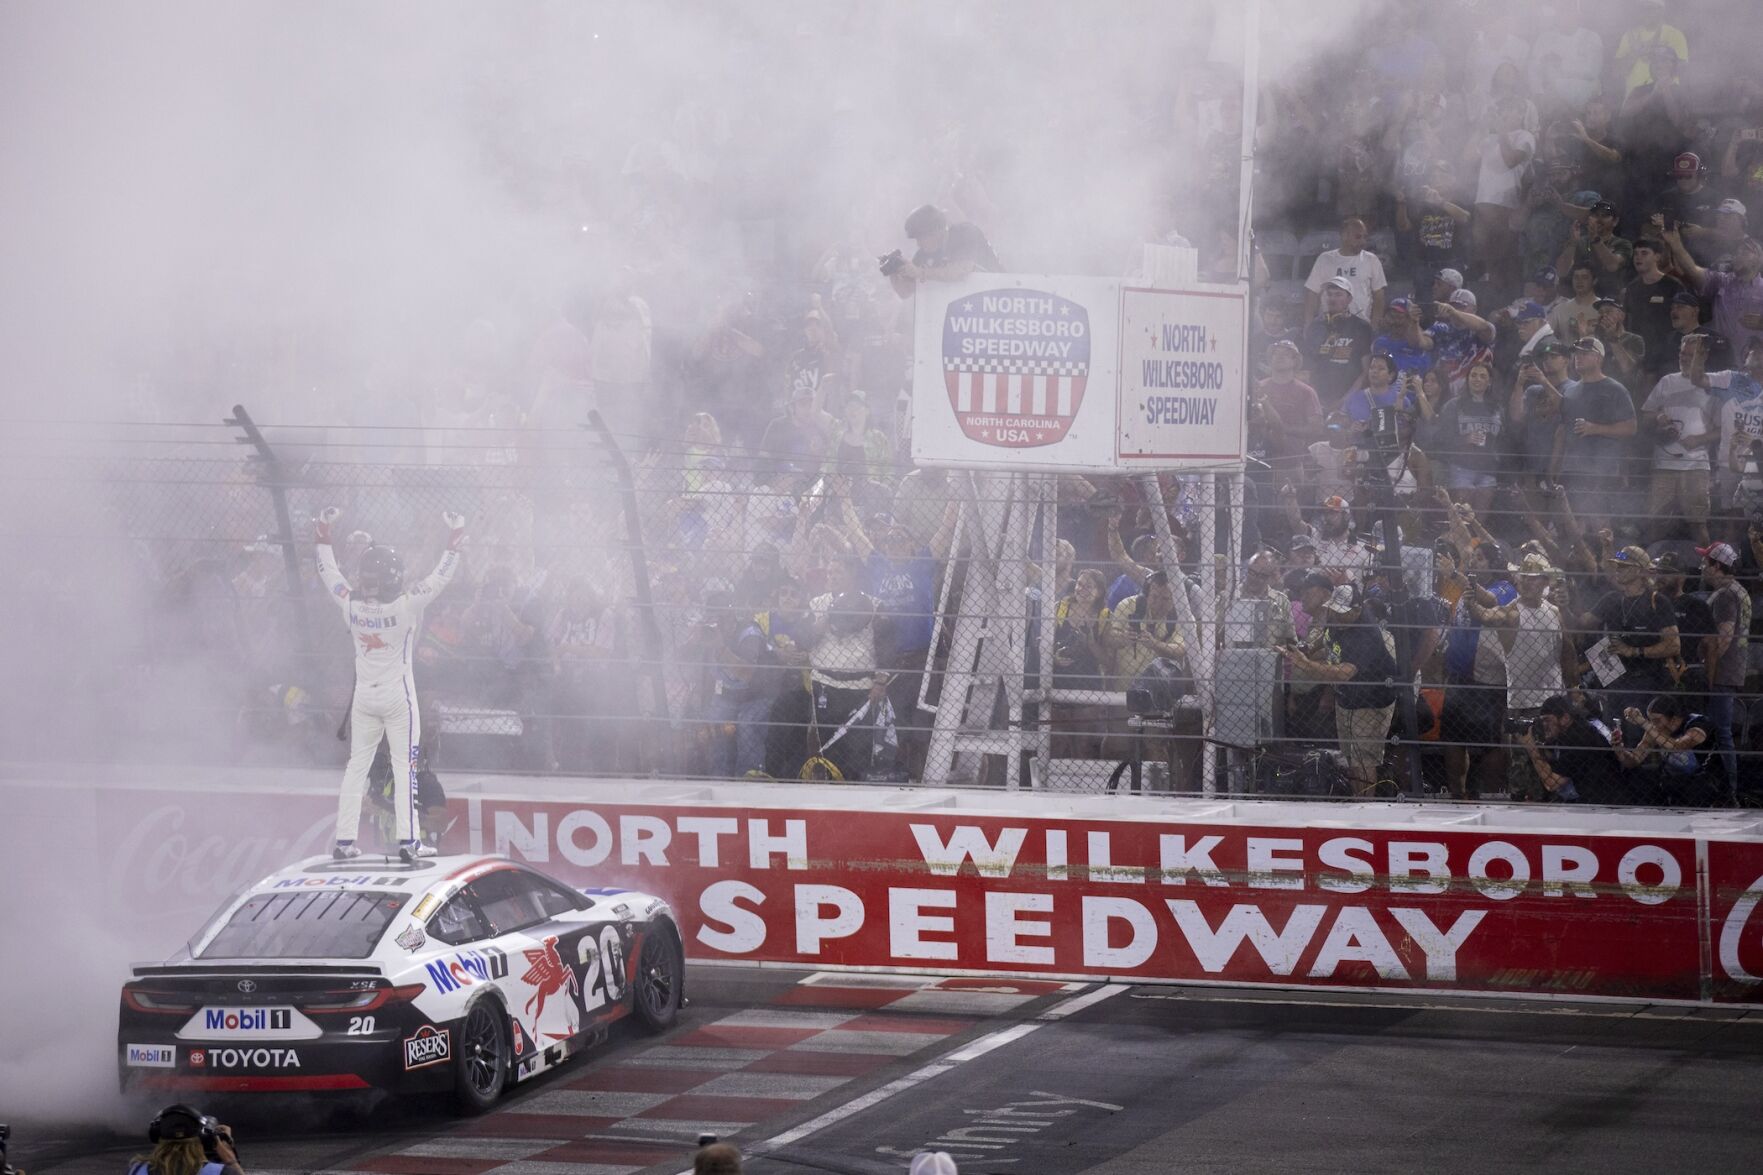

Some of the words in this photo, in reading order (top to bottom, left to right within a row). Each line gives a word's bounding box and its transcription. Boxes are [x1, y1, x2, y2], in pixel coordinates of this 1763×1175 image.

[982, 297, 1054, 315] NORTH
[950, 316, 1085, 338] WILKESBORO
[961, 339, 1072, 358] SPEEDWAY
[1162, 324, 1206, 353] NORTH
[1142, 359, 1223, 390] WILKESBORO
[1146, 397, 1218, 425] SPEEDWAY
[966, 417, 1004, 428] NORTH
[1005, 418, 1061, 430] CAROLINA
[996, 429, 1029, 443] USA
[350, 614, 382, 629] Mobil
[494, 809, 808, 871] NORTH
[909, 823, 1683, 906] WILKESBORO
[272, 876, 371, 889] Mobil
[696, 880, 1488, 982] SPEEDWAY
[425, 945, 491, 995] Mobil
[577, 925, 626, 1013] 20
[350, 981, 377, 990] XSE
[206, 1009, 266, 1030] Mobil
[348, 1016, 375, 1036] 20
[130, 1049, 160, 1062] Mobil
[208, 1049, 301, 1068] TOYOTA
[875, 1090, 1125, 1166] finity
